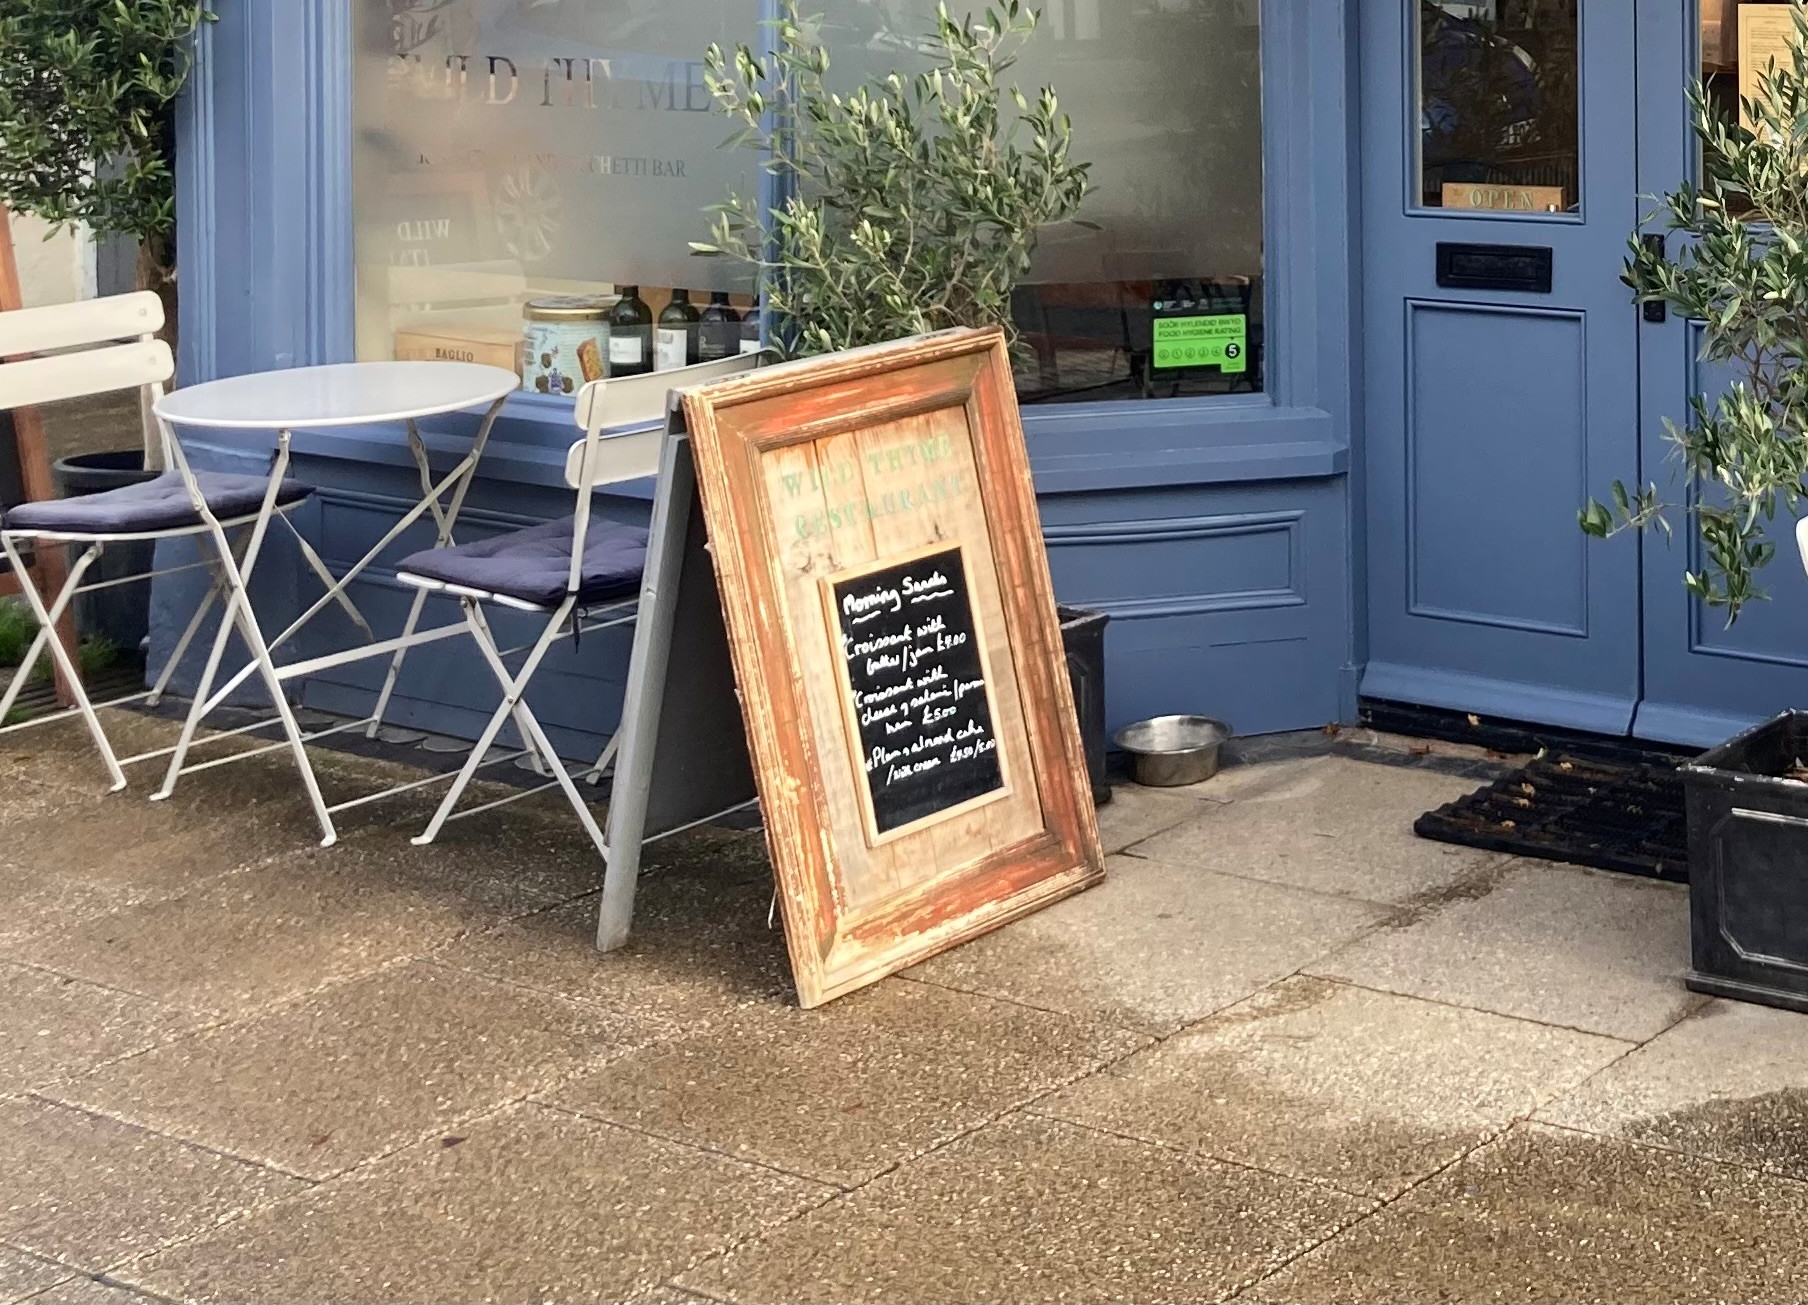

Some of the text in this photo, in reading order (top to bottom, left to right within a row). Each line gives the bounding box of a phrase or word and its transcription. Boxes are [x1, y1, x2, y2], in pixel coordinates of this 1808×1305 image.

[652, 157, 688, 179] BAR
[1469, 187, 1535, 209] OPEN
[1158, 329, 1181, 338] FOOD
[1214, 326, 1242, 335] RATING
[434, 347, 475, 363] BAGLIO
[1228, 344, 1239, 357] 5
[843, 587, 902, 615] Morning
[845, 615, 947, 659] Croissant with
[854, 665, 949, 709] Croissant with
